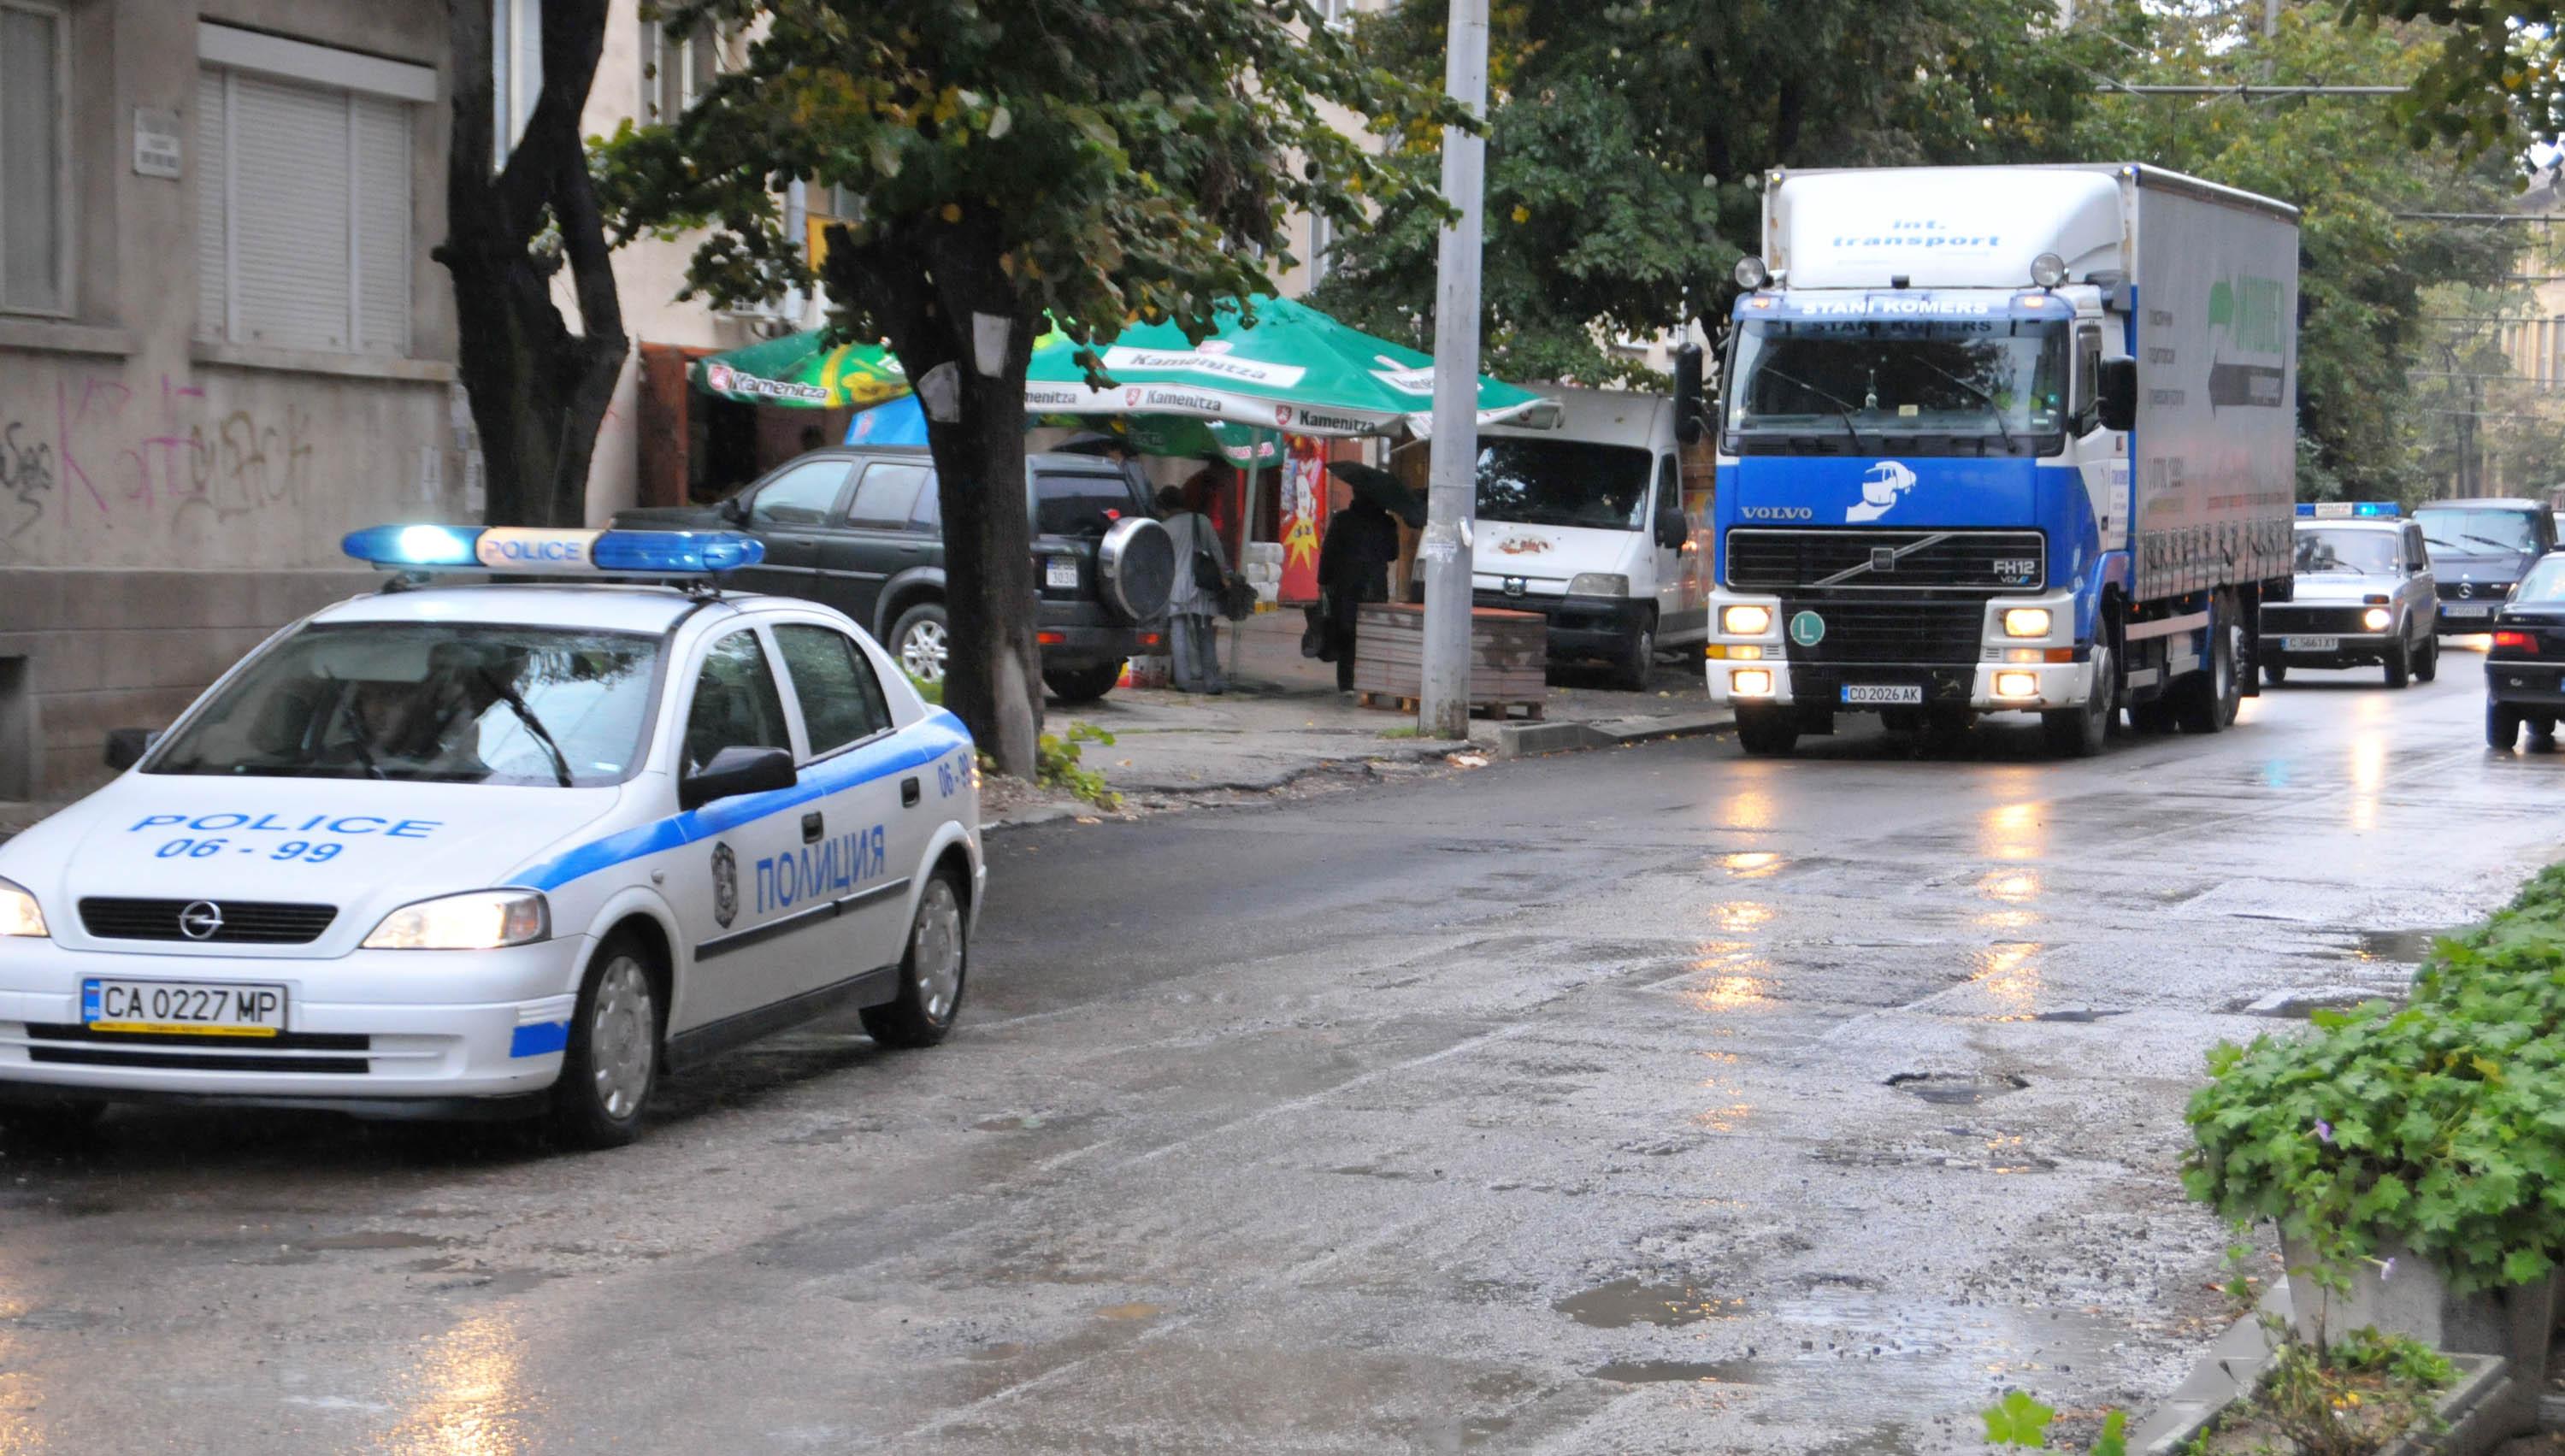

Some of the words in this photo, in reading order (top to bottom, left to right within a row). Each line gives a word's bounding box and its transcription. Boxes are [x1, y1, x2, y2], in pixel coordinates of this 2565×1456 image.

[1891, 219, 1945, 229] int.
[1833, 236, 2000, 247] transport
[1801, 300, 1875, 315] STANI
[1883, 300, 1990, 315] KOMERS
[1130, 353, 1268, 380] Kamenitza
[730, 370, 828, 399] Kamenitza
[1026, 390, 1077, 404] menitza
[1146, 389, 1222, 411] Kamenitza
[1300, 409, 1377, 431] Kamenitza
[1741, 506, 1813, 520] VOLVO
[485, 540, 582, 561] POLICE
[1993, 560, 2035, 575] FH12
[1800, 617, 1814, 640] L
[1849, 687, 1866, 701] CO
[1868, 687, 1900, 701] 2026
[1902, 687, 1918, 701] AK
[937, 761, 954, 798] 06
[127, 813, 445, 839] POLICE
[155, 838, 230, 858] 06
[268, 840, 344, 864] 99
[756, 823, 885, 915] ПОЛИЦИЯ
[104, 986, 144, 1018] CA
[152, 987, 229, 1022] 0227
[236, 990, 277, 1023] MP
